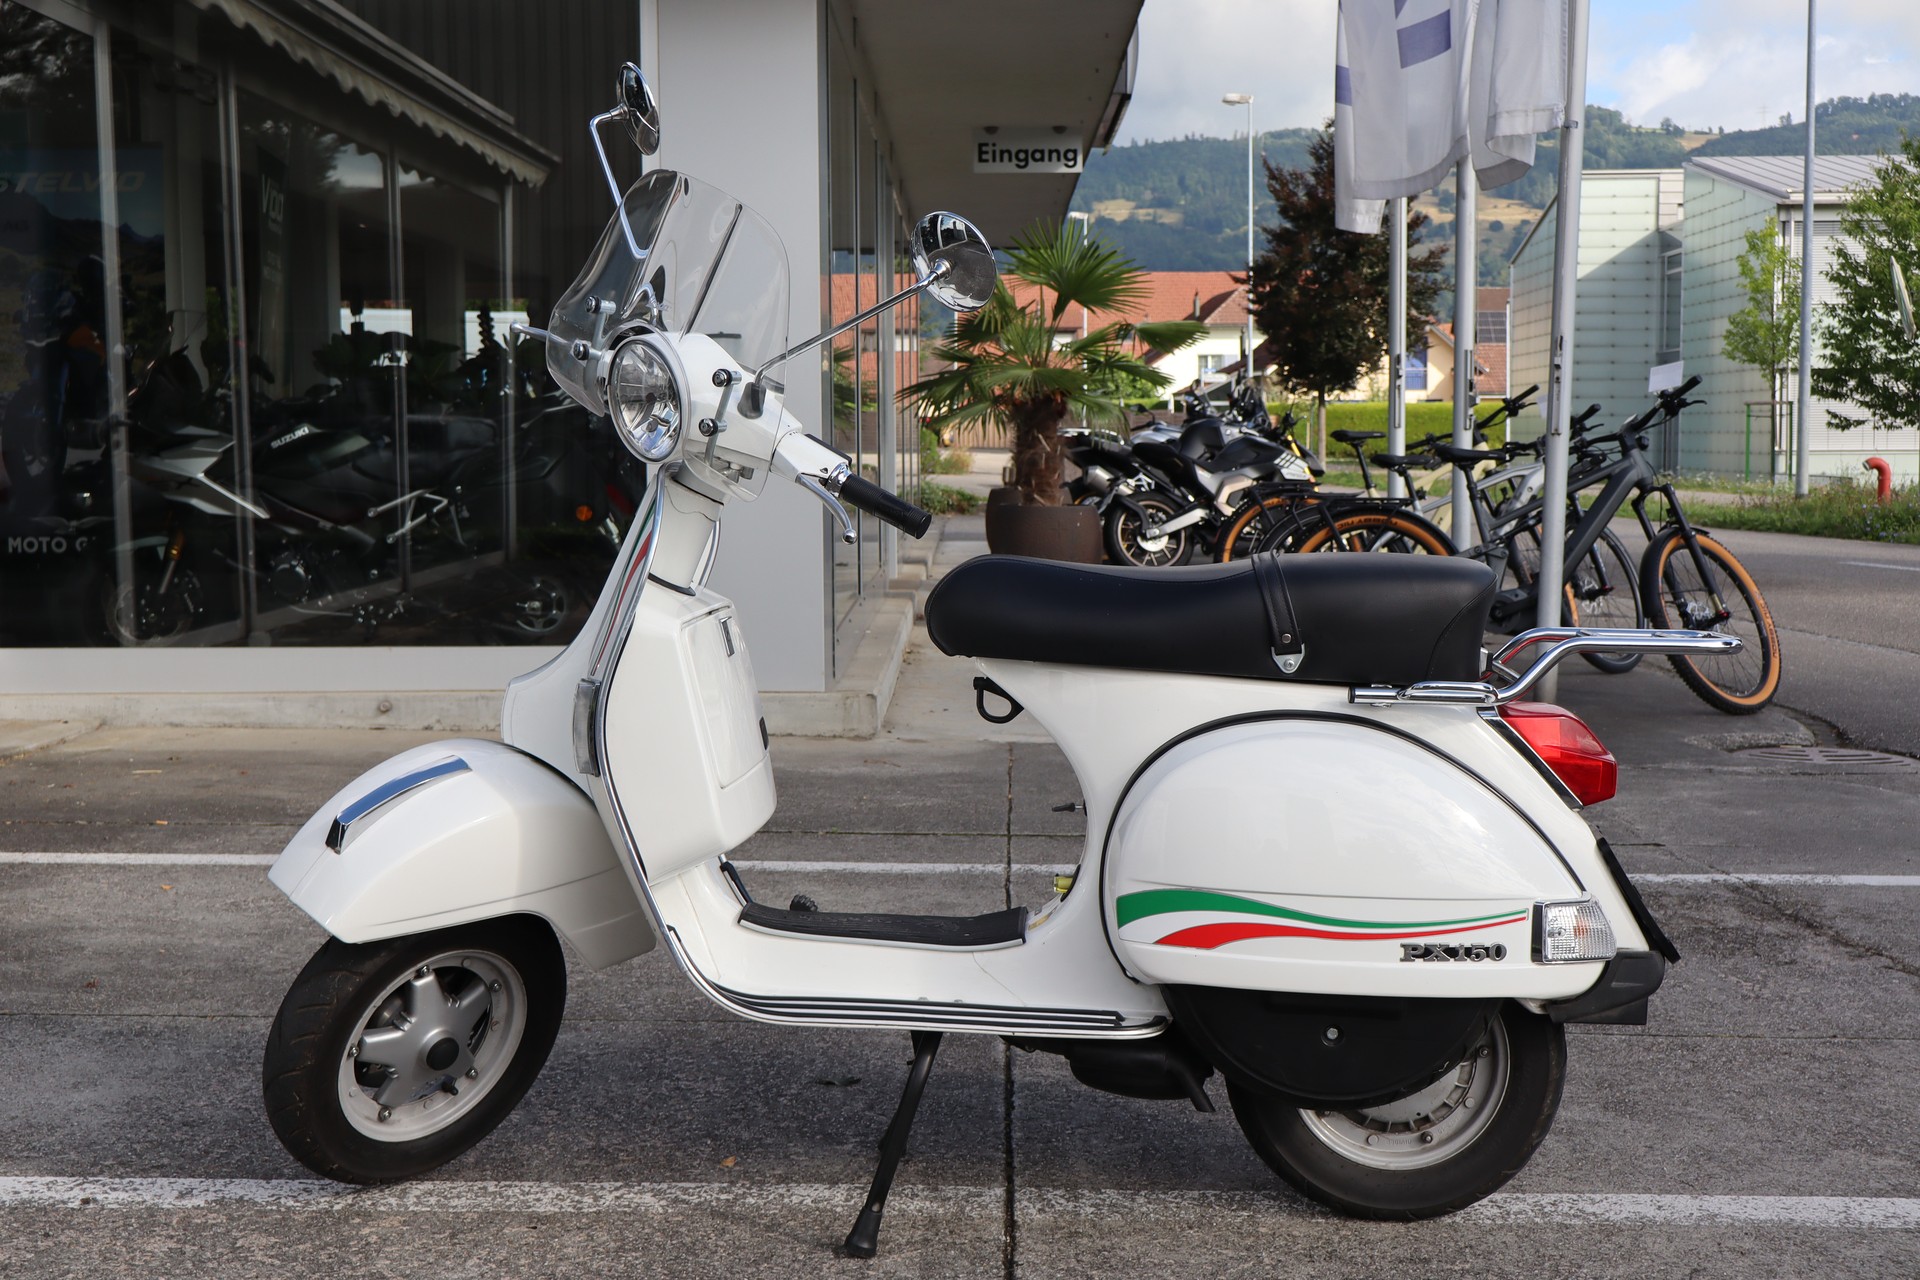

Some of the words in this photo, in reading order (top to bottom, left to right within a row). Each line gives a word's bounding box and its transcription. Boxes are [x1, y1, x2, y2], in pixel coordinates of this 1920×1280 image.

[977, 143, 1078, 169] Eingang
[0, 171, 145, 194] TELVO
[270, 426, 309, 449] SUZUKI
[8, 536, 67, 554] MOTO
[1399, 942, 1508, 962] PX150
